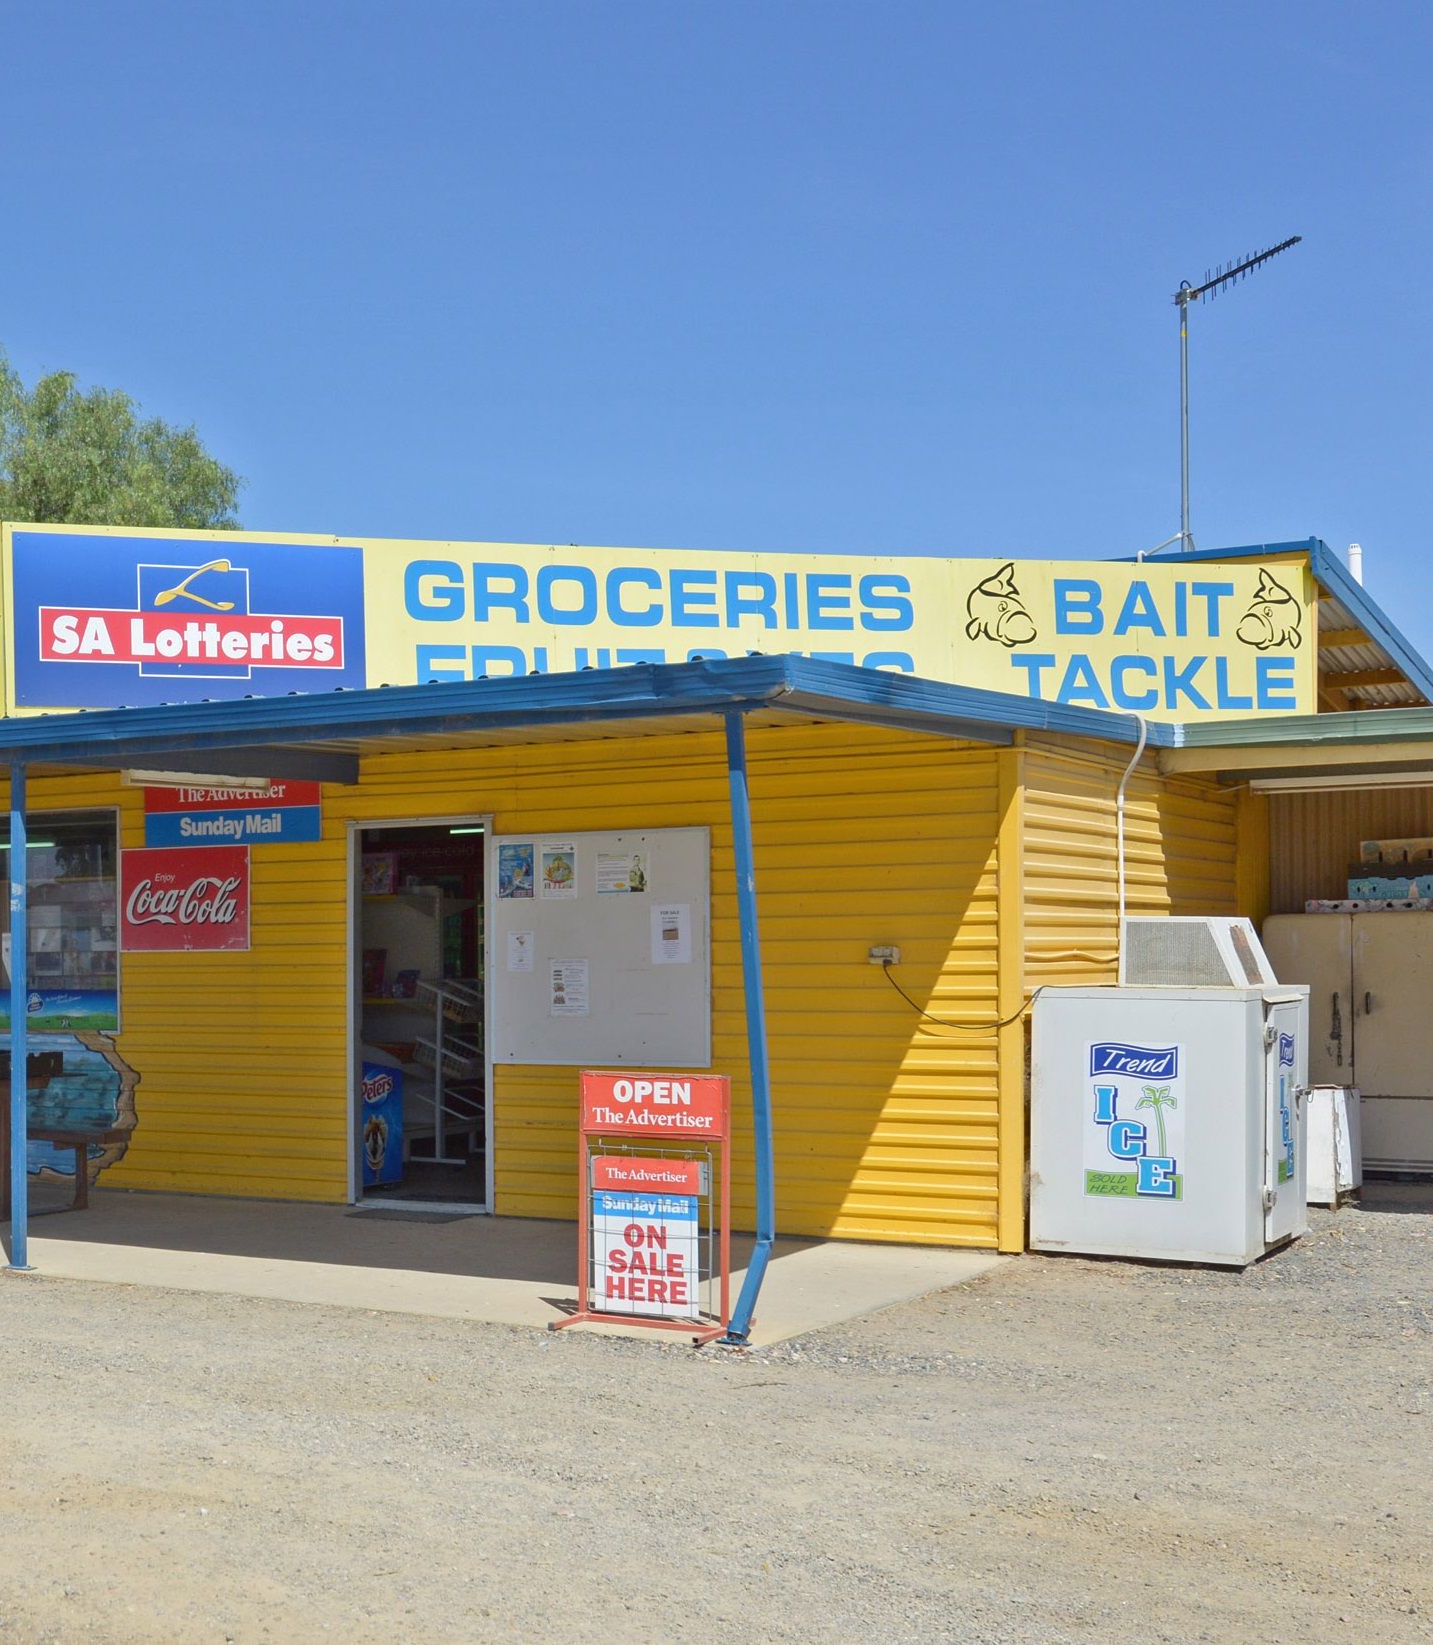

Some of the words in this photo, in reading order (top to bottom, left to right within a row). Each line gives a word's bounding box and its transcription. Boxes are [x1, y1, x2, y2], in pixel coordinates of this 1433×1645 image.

[404, 559, 914, 631] GROCERIES
[1053, 578, 1234, 637] BAIT
[52, 615, 115, 655] SA
[130, 618, 335, 662] Lotteries
[1011, 653, 1297, 710] TACKLE
[176, 787, 206, 803] The
[180, 815, 244, 840] Sunday
[246, 813, 282, 834] Mail
[155, 873, 175, 883] Enjoy
[126, 877, 241, 925] Coca-Cola
[1103, 1049, 1171, 1073] Trend
[613, 1080, 691, 1105] OPEN
[592, 1107, 624, 1123] The
[625, 1108, 713, 1128] Advertiser
[1094, 1085, 1176, 1197] ICE
[606, 1167, 628, 1180] The
[628, 1169, 687, 1183] Advertiser
[1090, 1174, 1127, 1184] SOLD
[1089, 1184, 1128, 1194] HERE
[602, 1196, 658, 1215] Sunday
[658, 1198, 688, 1214] Mail
[623, 1223, 667, 1250] ON
[608, 1249, 684, 1278] SALE
[606, 1275, 687, 1305] HERE
